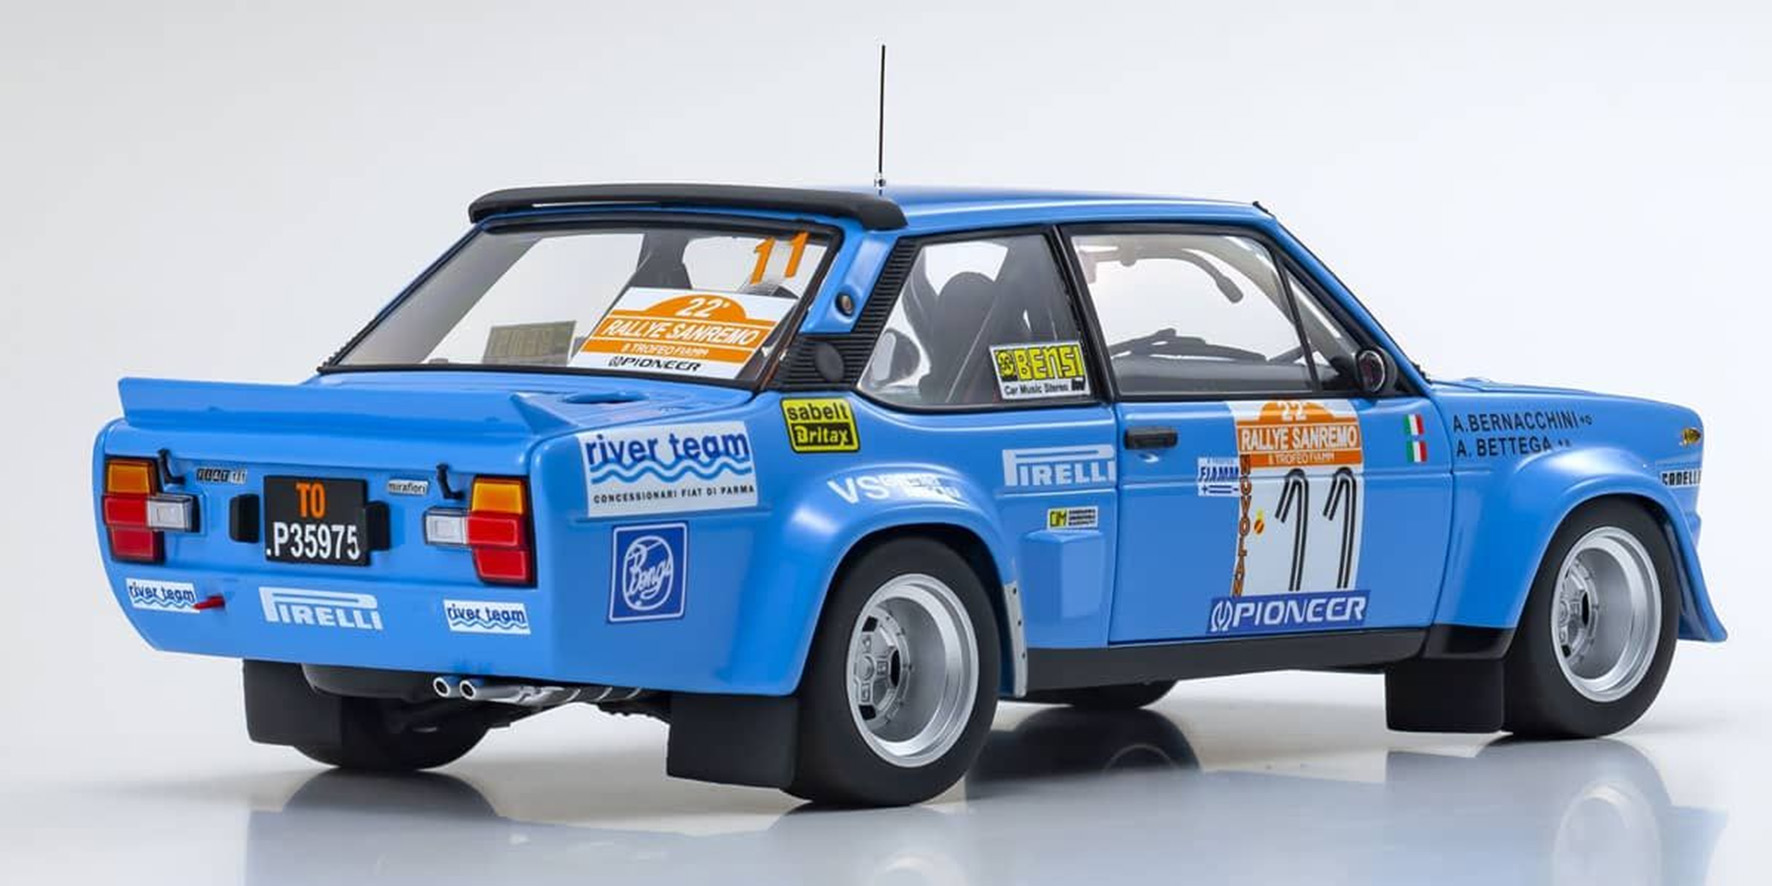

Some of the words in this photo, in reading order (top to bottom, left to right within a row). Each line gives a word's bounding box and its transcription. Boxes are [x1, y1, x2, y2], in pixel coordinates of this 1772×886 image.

[751, 231, 810, 285] 11
[601, 319, 668, 339] RALLYE
[666, 322, 760, 345] SANREMO
[621, 356, 702, 371] PIONEER
[787, 402, 850, 421] sabelt
[585, 434, 658, 465] river
[668, 433, 750, 462] team
[1241, 427, 1289, 450] RALLYE
[1292, 425, 1358, 449] SANREMO
[1476, 436, 1553, 457] BETTEGA
[1002, 444, 1117, 487] PIRELLI
[295, 481, 326, 519] TO
[593, 490, 678, 505] CONCESSIONARI
[681, 487, 702, 498] FIAT
[706, 486, 717, 496] DI
[721, 484, 755, 495] PARMA
[1274, 466, 1357, 592] 11
[128, 581, 158, 599] river
[161, 586, 196, 603] team
[259, 586, 384, 631] PIRELLI
[446, 603, 482, 621] river
[485, 606, 526, 623] team
[1232, 596, 1367, 628] PIONEER
